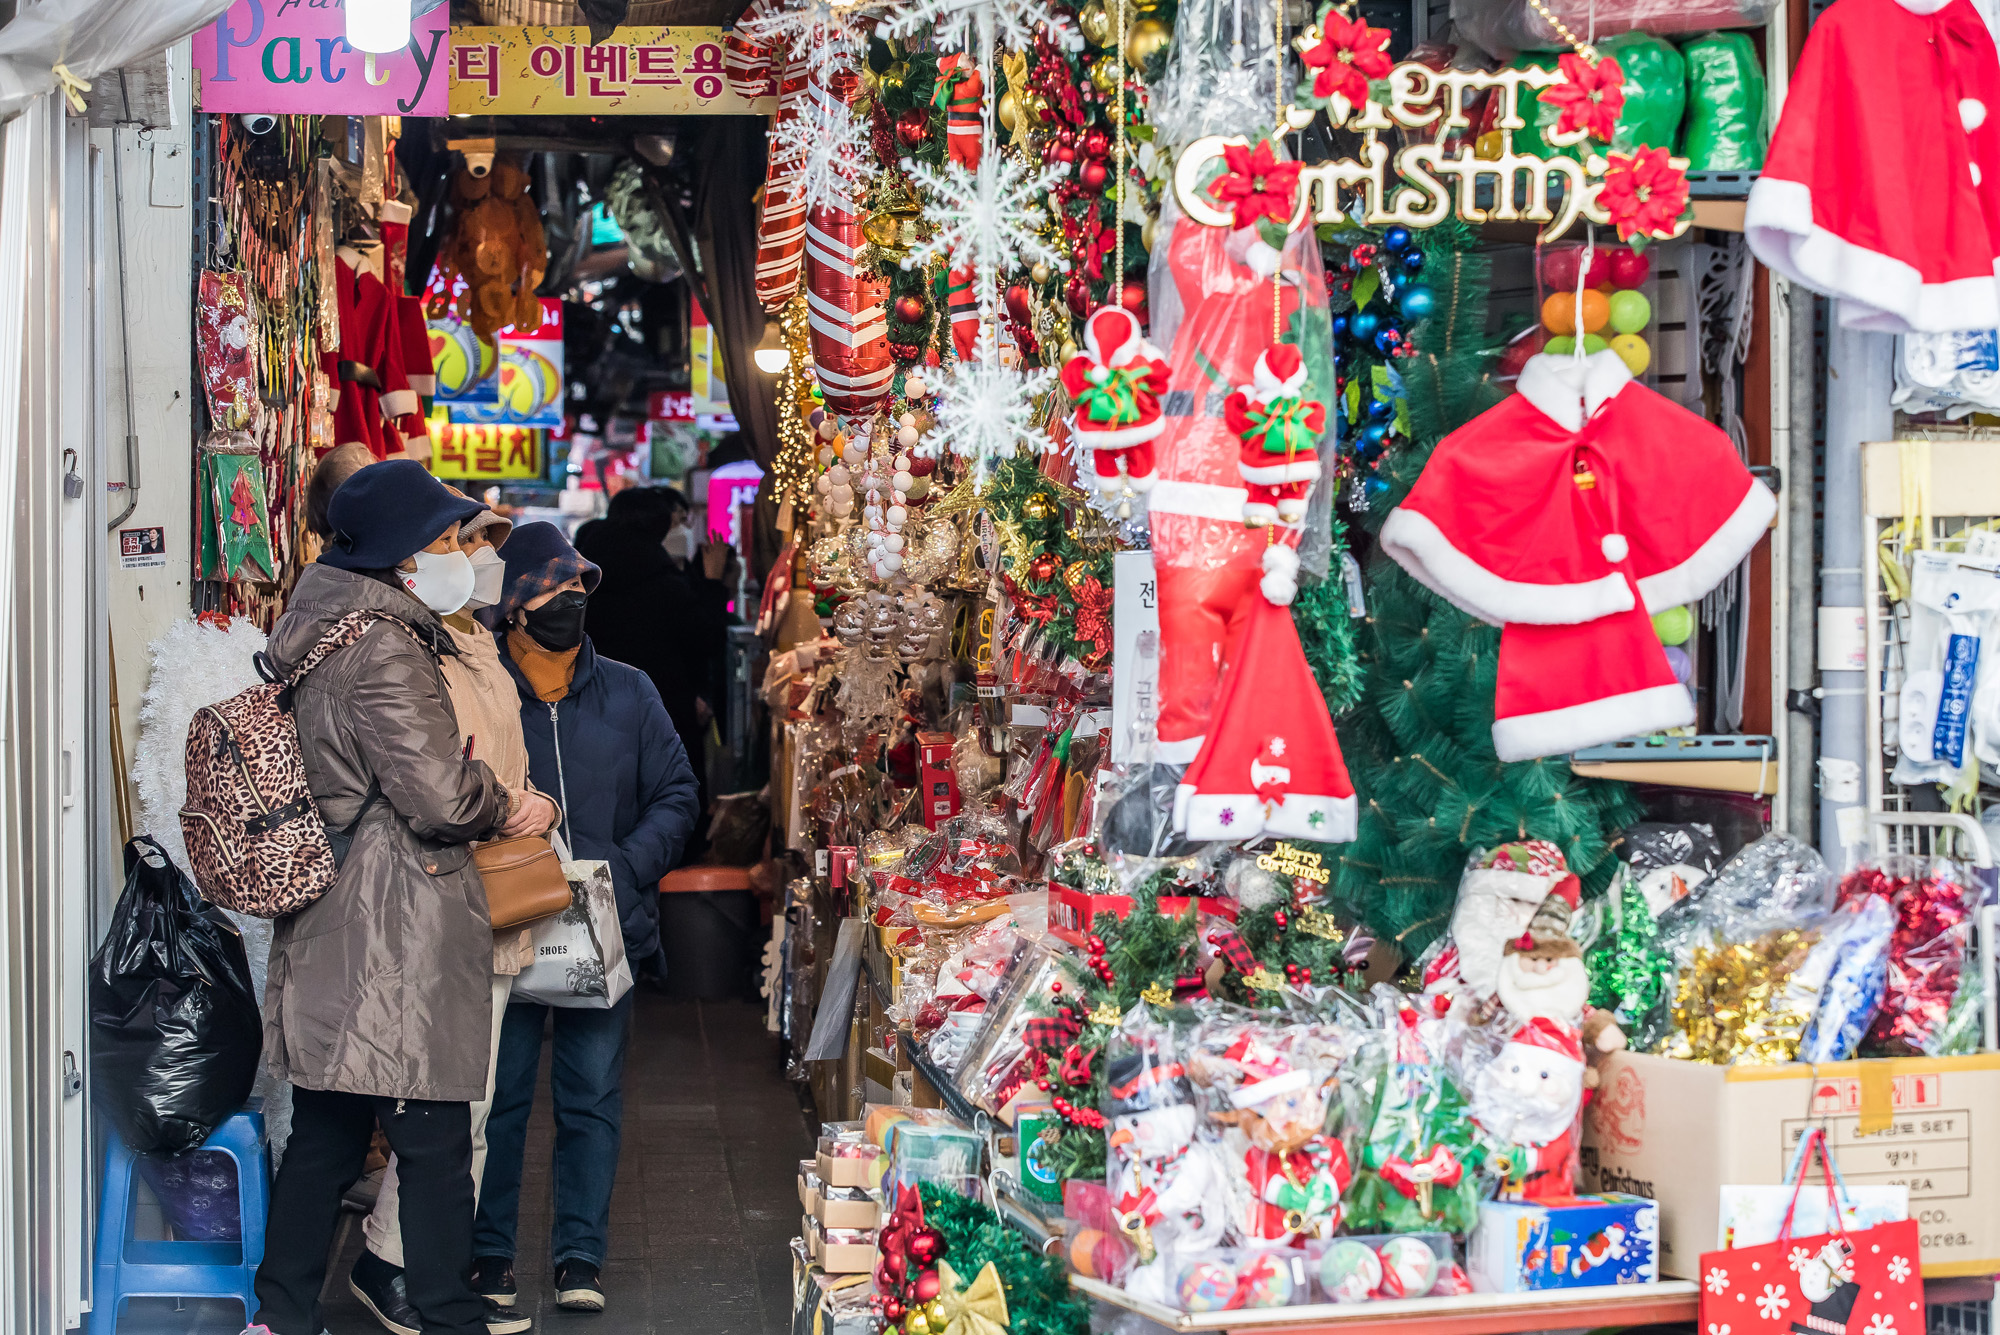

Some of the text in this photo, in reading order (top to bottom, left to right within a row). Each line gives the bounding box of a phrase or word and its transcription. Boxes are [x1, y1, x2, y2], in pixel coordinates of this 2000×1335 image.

[449, 43, 777, 98] 티 이벤트용
[1174, 134, 1692, 243] Cristm
[426, 423, 536, 472] 락갈치
[1272, 841, 1322, 867] Merry
[1256, 854, 1331, 885] Christmas
[540, 945, 568, 955] SHOES
[1921, 1120, 1953, 1133] SET
[1919, 1231, 1974, 1249] orea.
